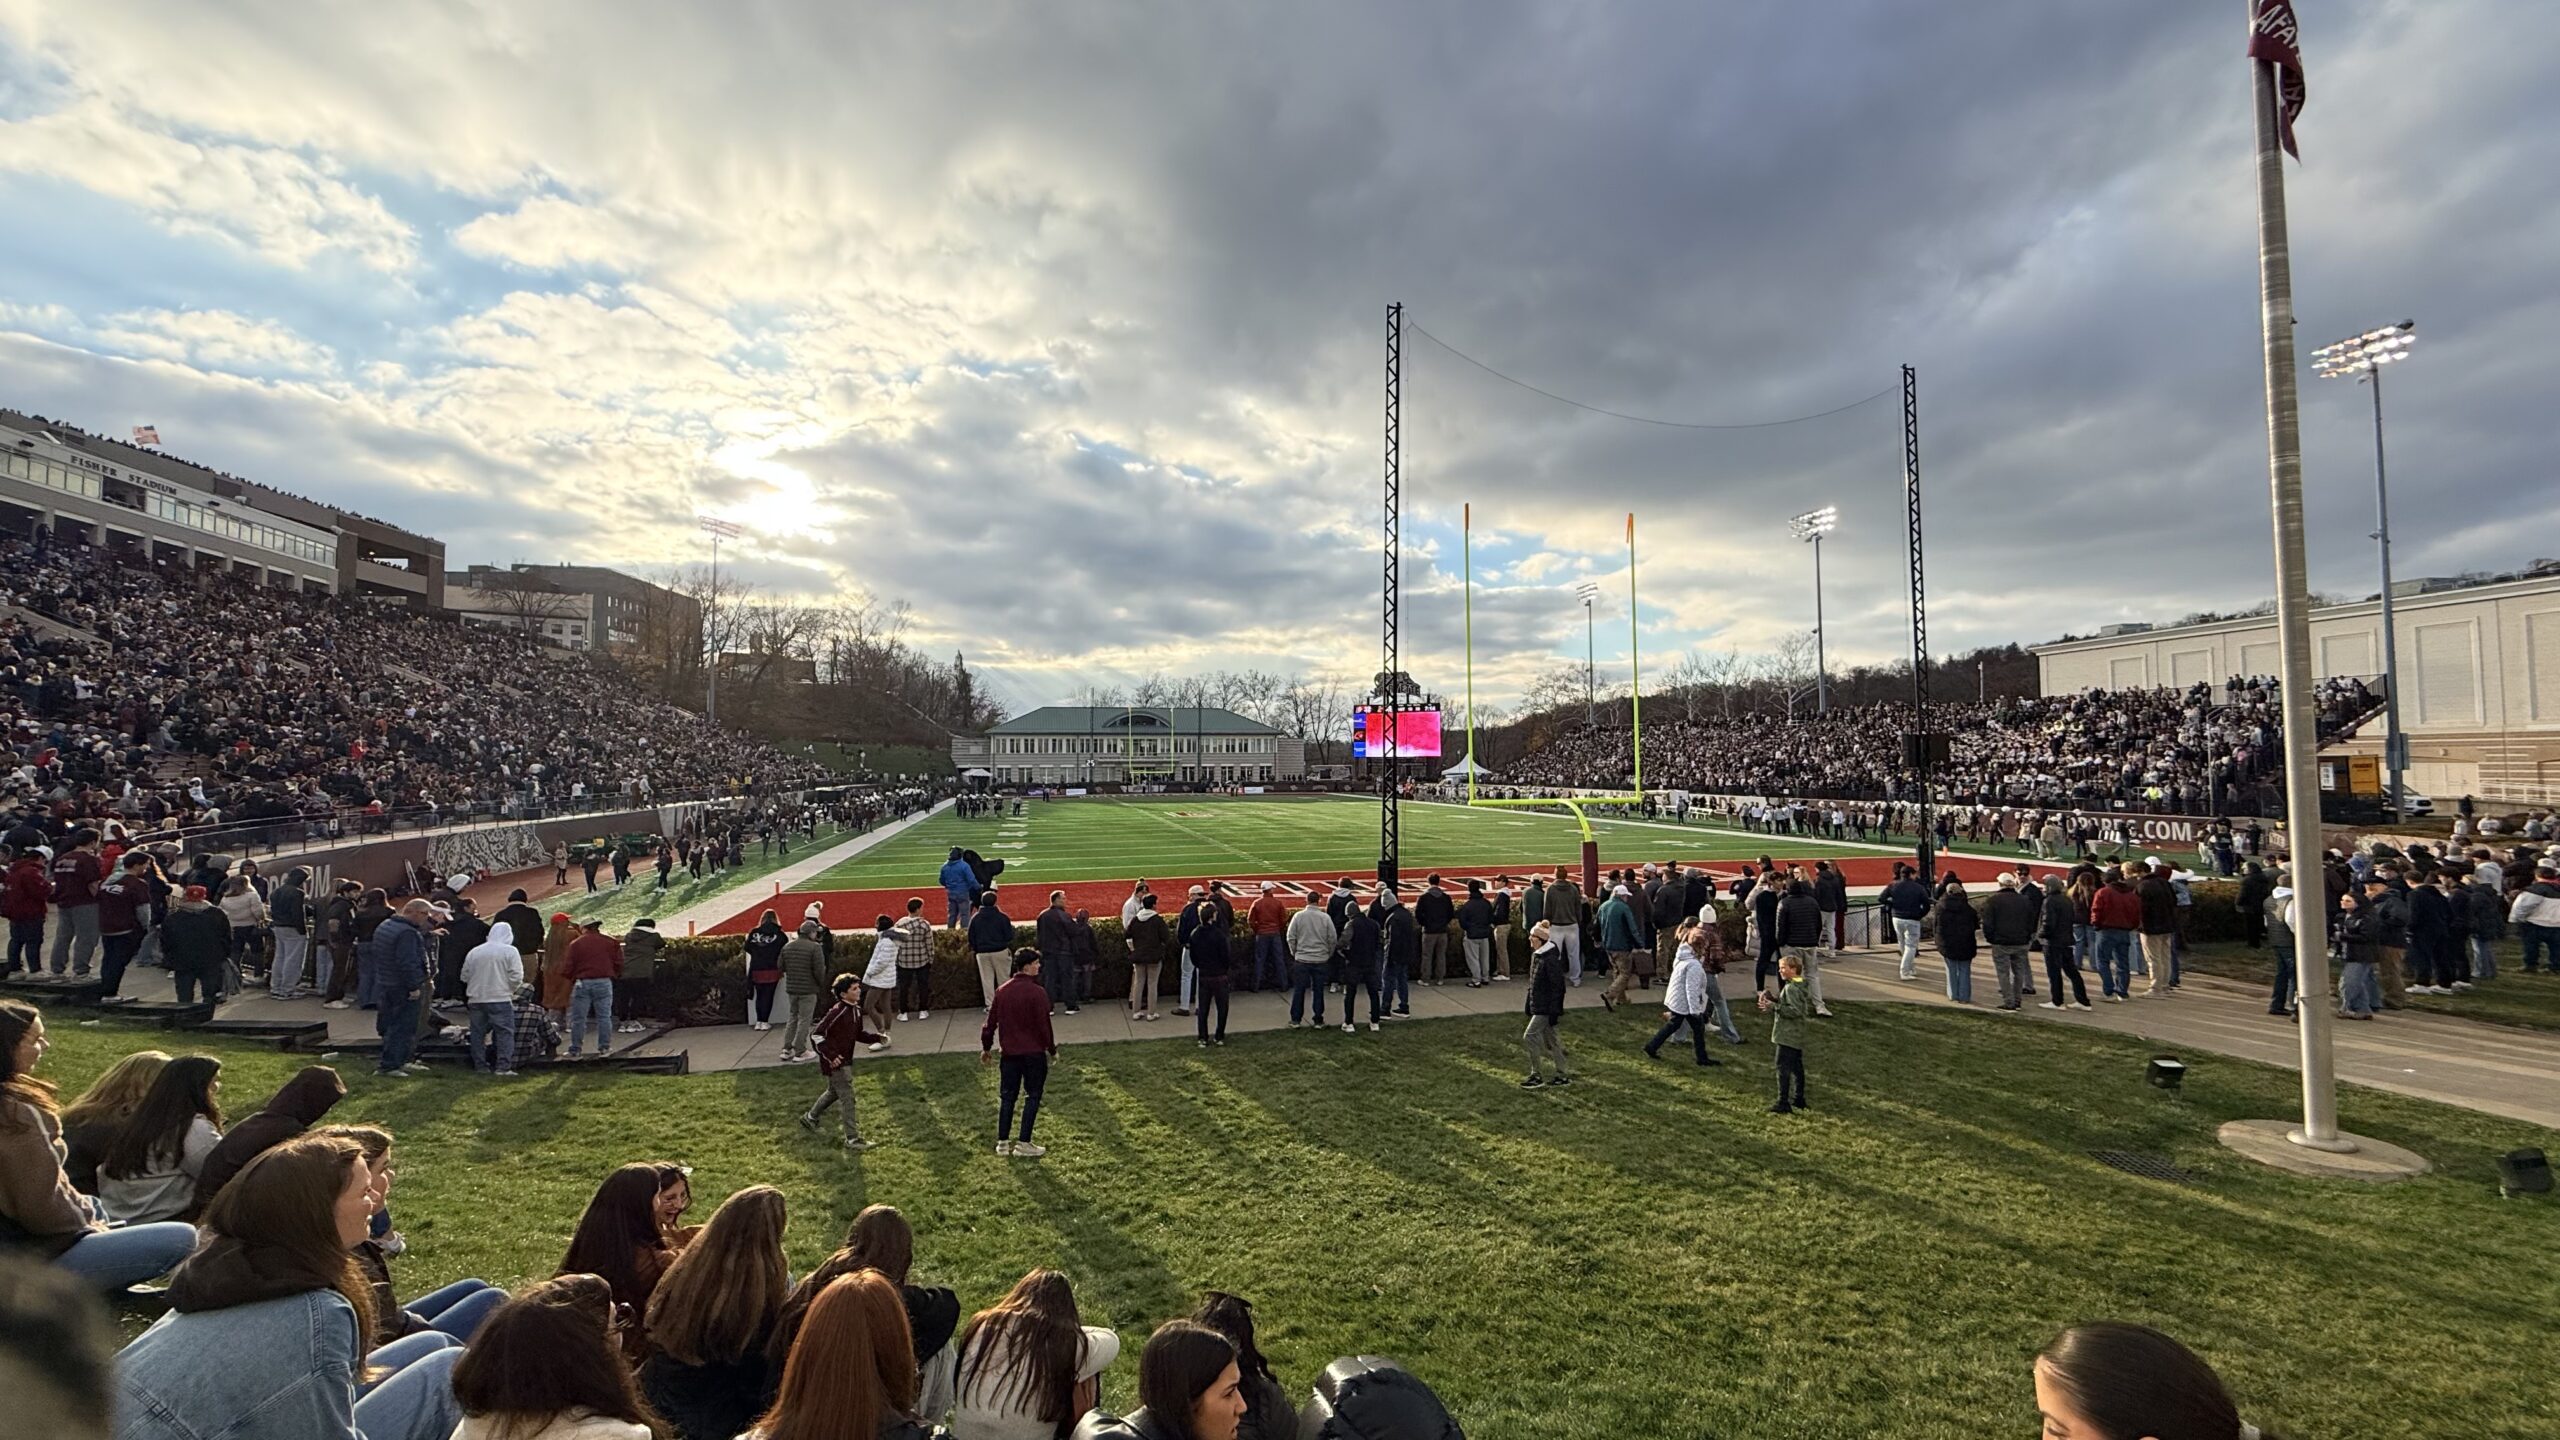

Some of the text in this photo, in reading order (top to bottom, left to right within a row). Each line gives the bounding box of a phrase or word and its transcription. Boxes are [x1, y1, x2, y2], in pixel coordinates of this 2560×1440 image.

[70, 455, 177, 495] FISHER STADIUM
[1086, 759, 1095, 767] 25
